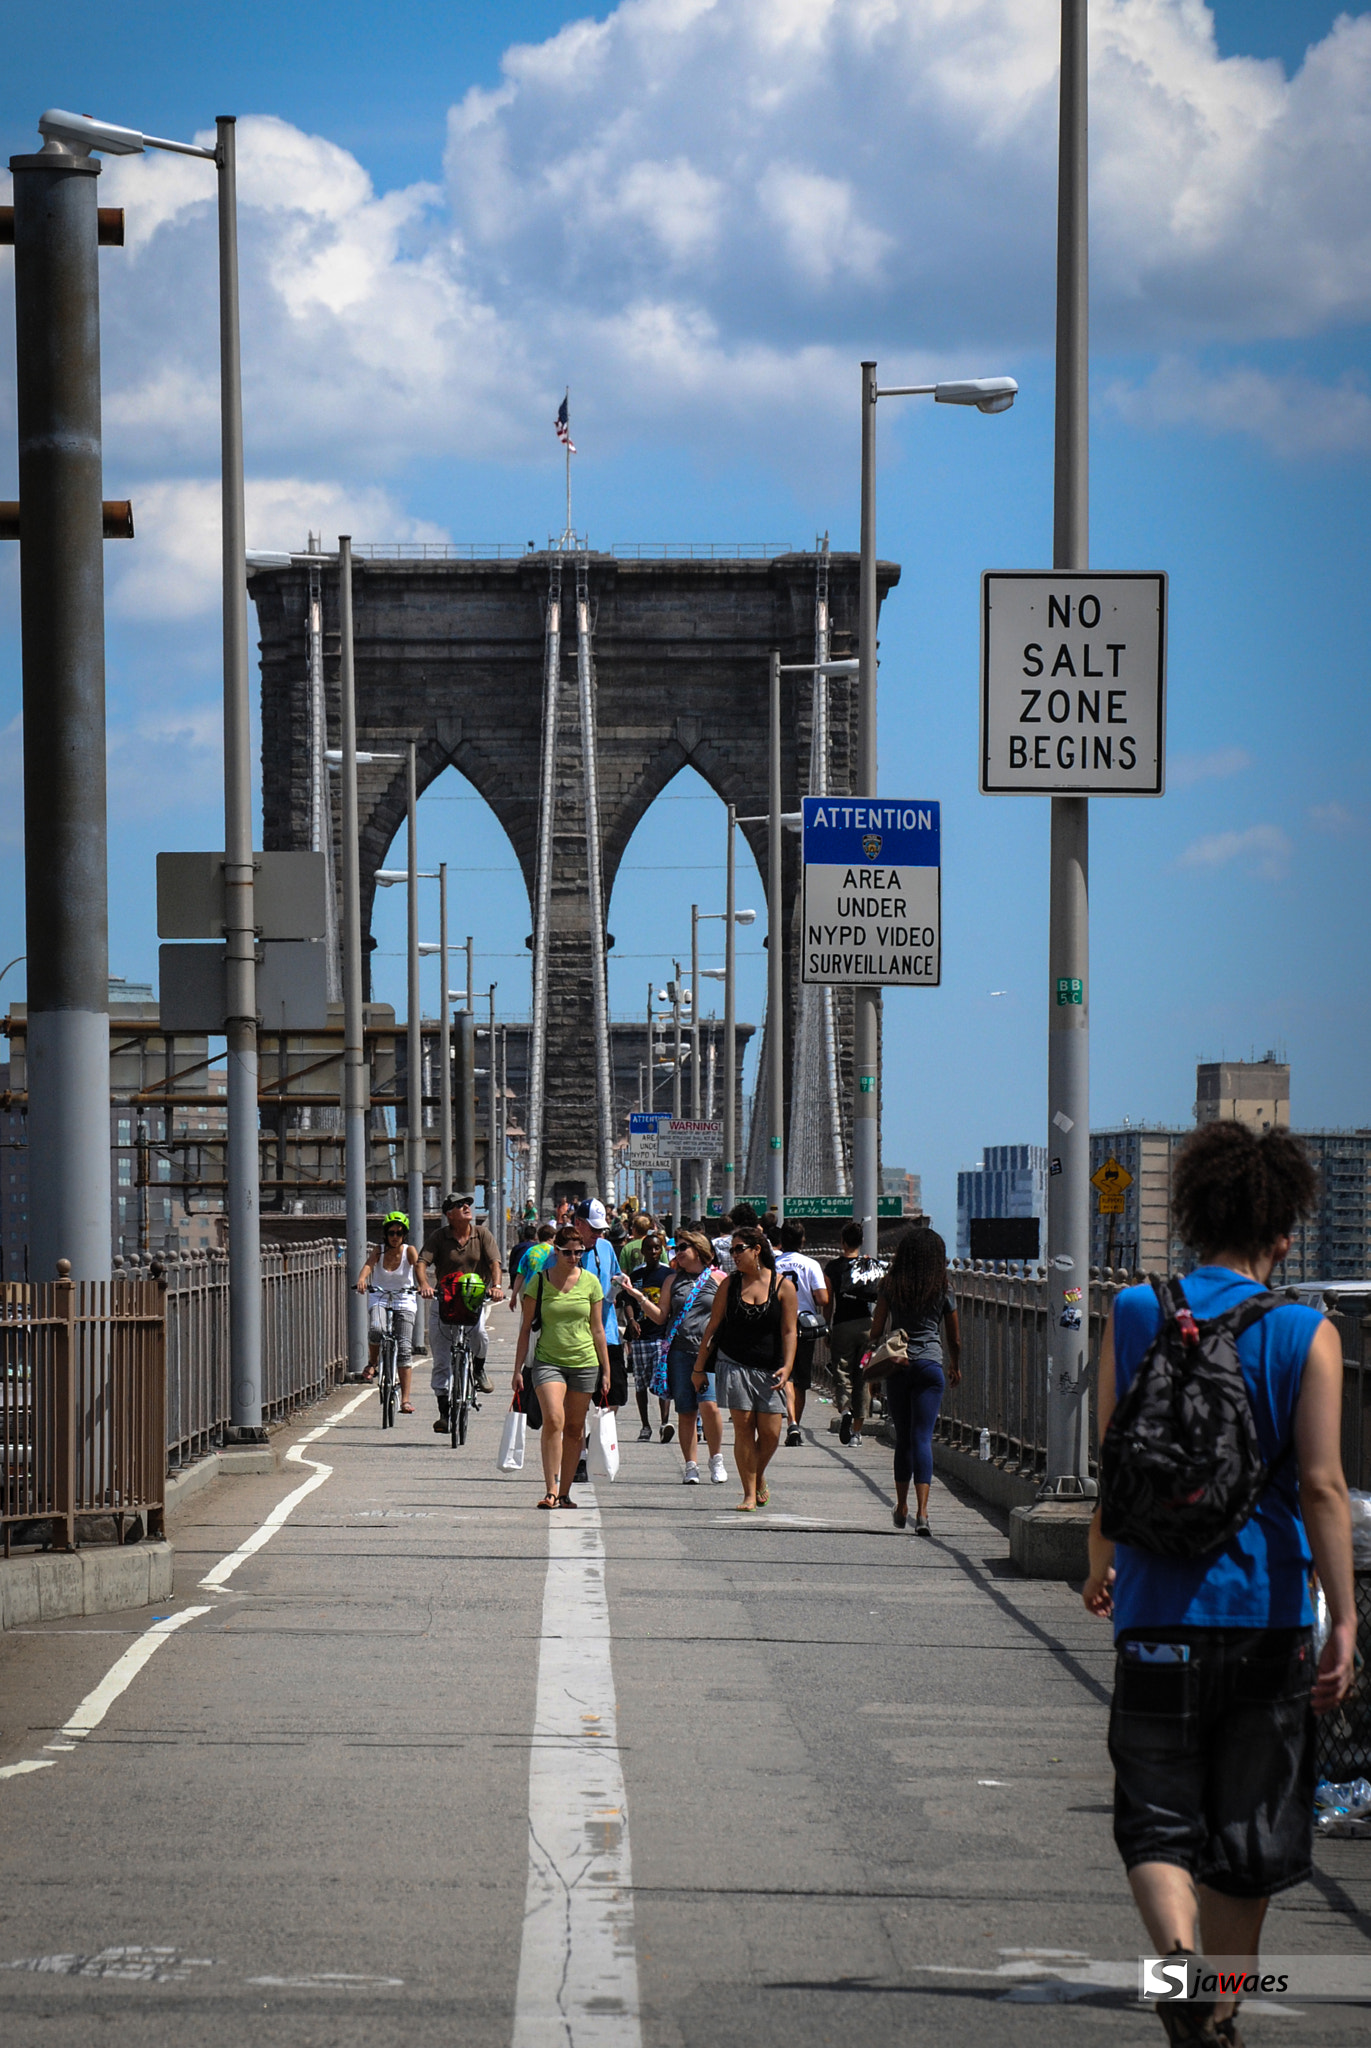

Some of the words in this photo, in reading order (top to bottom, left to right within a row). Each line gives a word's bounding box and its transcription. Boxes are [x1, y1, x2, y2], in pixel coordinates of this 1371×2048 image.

[1048, 594, 1101, 628] NO
[1022, 643, 1126, 677] SALT
[1019, 689, 1127, 723] ZONE
[1010, 736, 1137, 770] BEGINS
[813, 807, 932, 830] ATTENTION
[843, 869, 902, 890] AREA
[837, 897, 907, 918] UNDER
[809, 925, 866, 946] NYPD
[876, 926, 935, 947] VIDEO
[809, 954, 933, 975] SURVEILLANCE
[640, 1142, 657, 1150] UNDE
